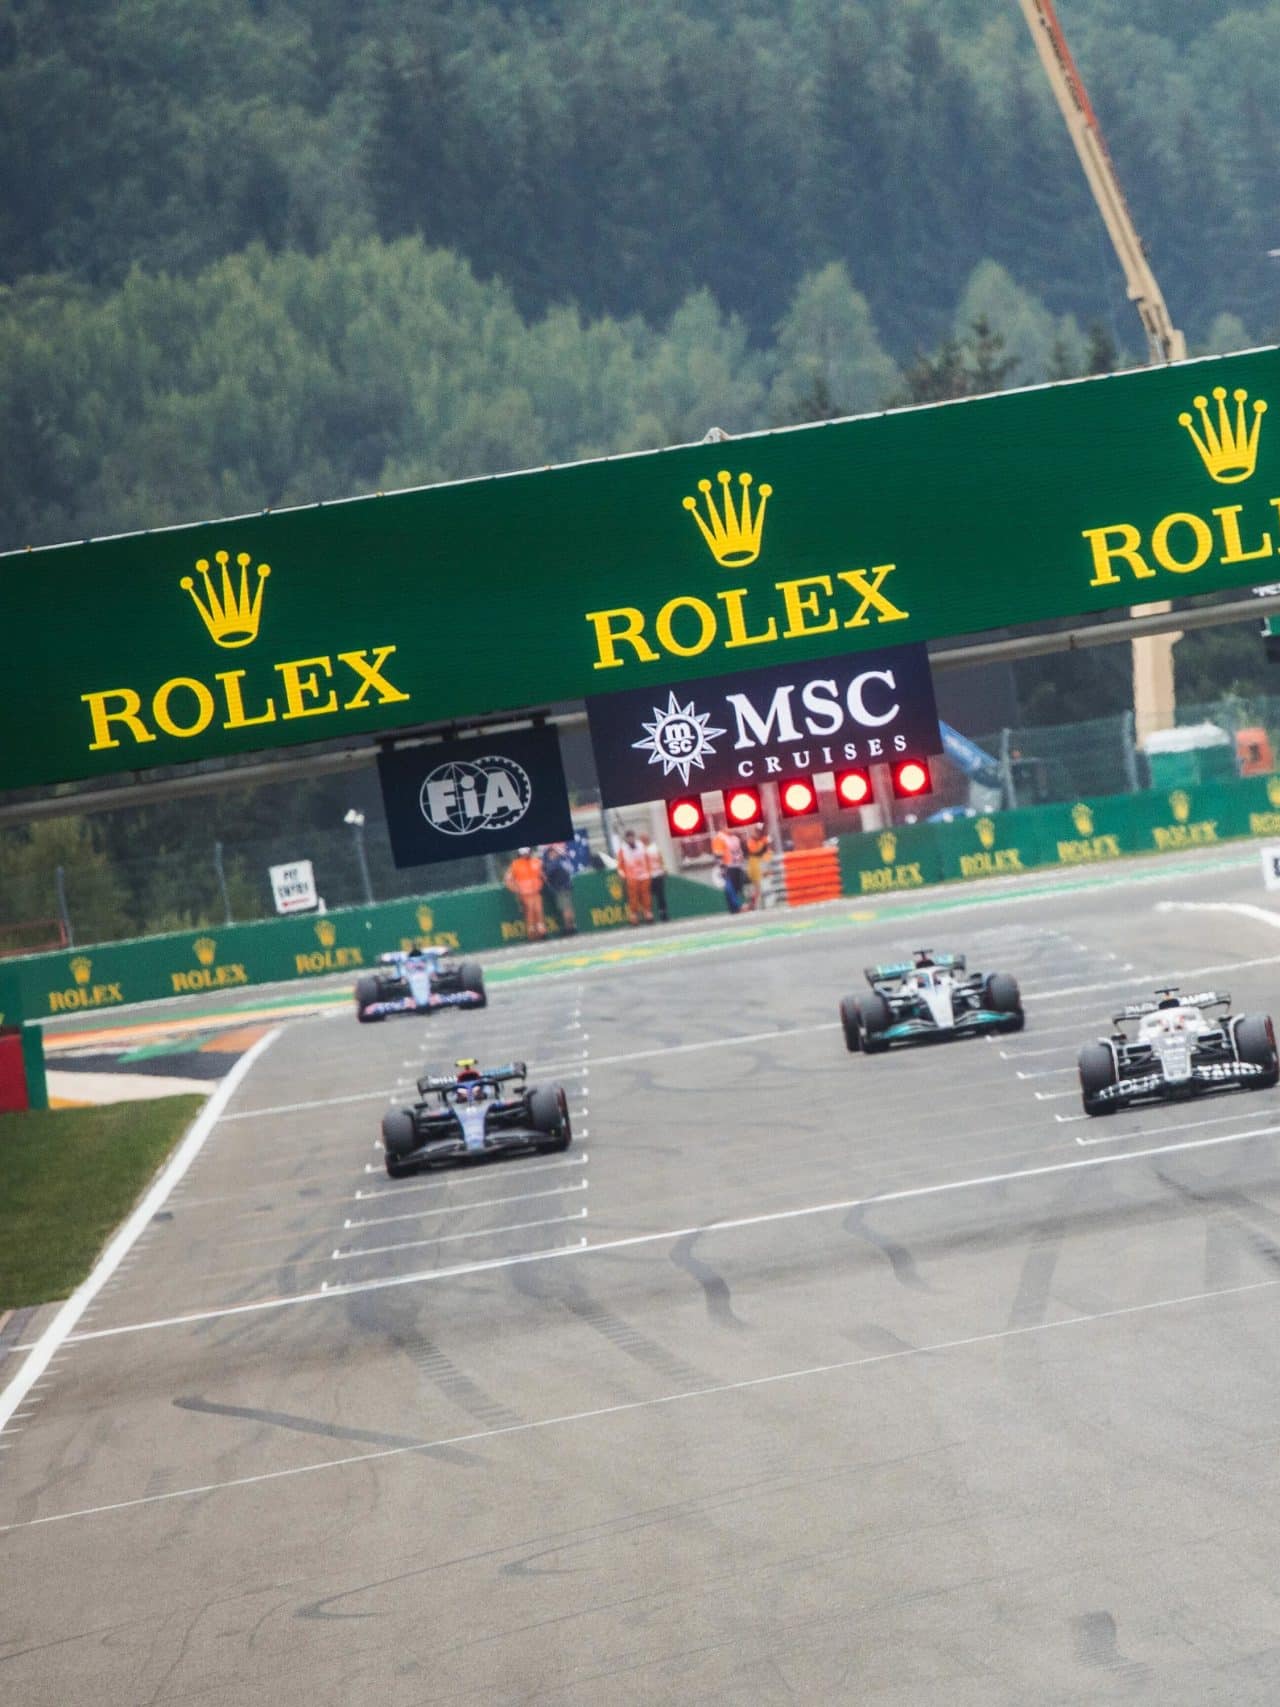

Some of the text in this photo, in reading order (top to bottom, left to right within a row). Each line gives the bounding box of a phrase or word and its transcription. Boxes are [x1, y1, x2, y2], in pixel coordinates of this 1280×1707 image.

[586, 563, 909, 669] ROLEX
[81, 644, 410, 751] ROLEX
[726, 669, 901, 750] MSC
[738, 735, 908, 777] CRUISES
[860, 862, 923, 892] ROLEX
[960, 848, 1024, 877] ROLEX
[295, 947, 364, 973] ROLEX
[172, 963, 248, 992] ROLEX
[49, 982, 124, 1012] ROLEX
